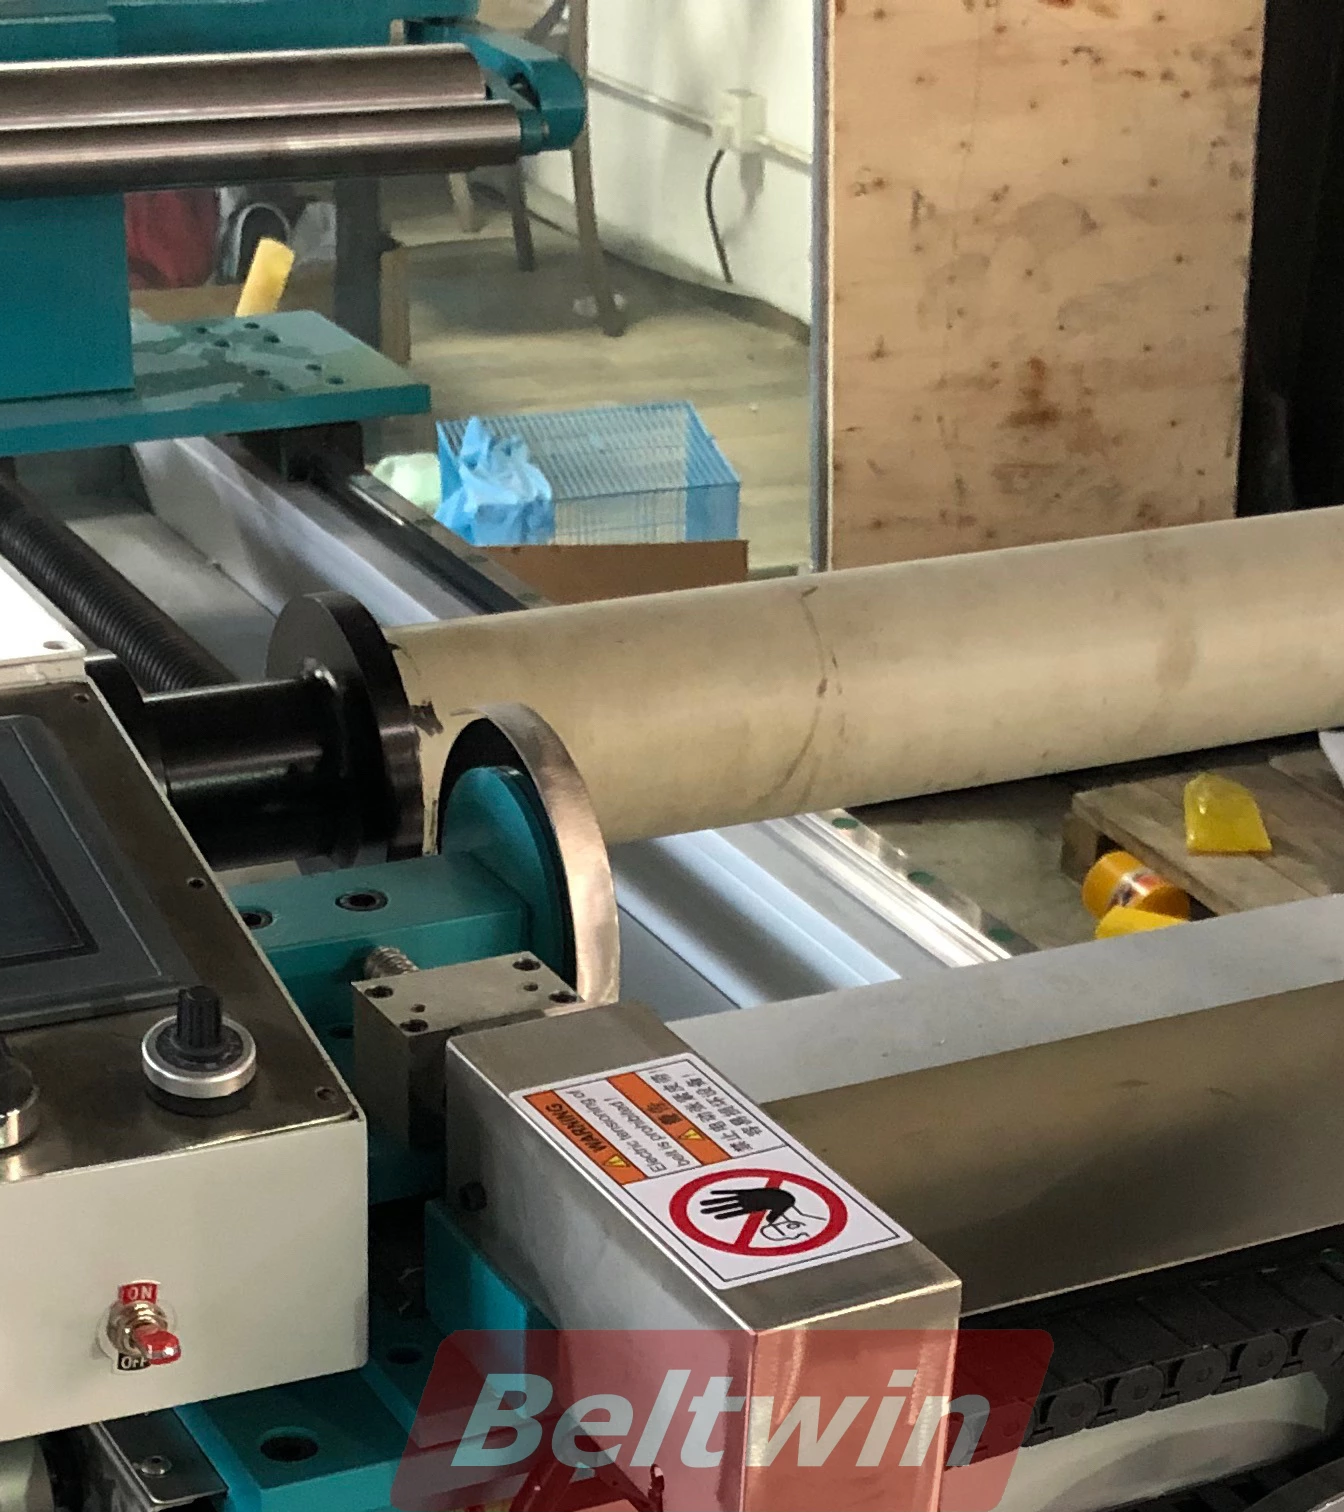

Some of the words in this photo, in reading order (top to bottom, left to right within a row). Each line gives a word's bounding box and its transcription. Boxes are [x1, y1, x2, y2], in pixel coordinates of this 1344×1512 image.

[565, 1089, 584, 1099] of
[543, 1103, 608, 1152] WARNING
[578, 1098, 633, 1141] tensioning
[609, 1100, 665, 1140] prohibited
[624, 1140, 667, 1172] Electric
[664, 1149, 691, 1167] belt
[127, 1285, 153, 1300] ON
